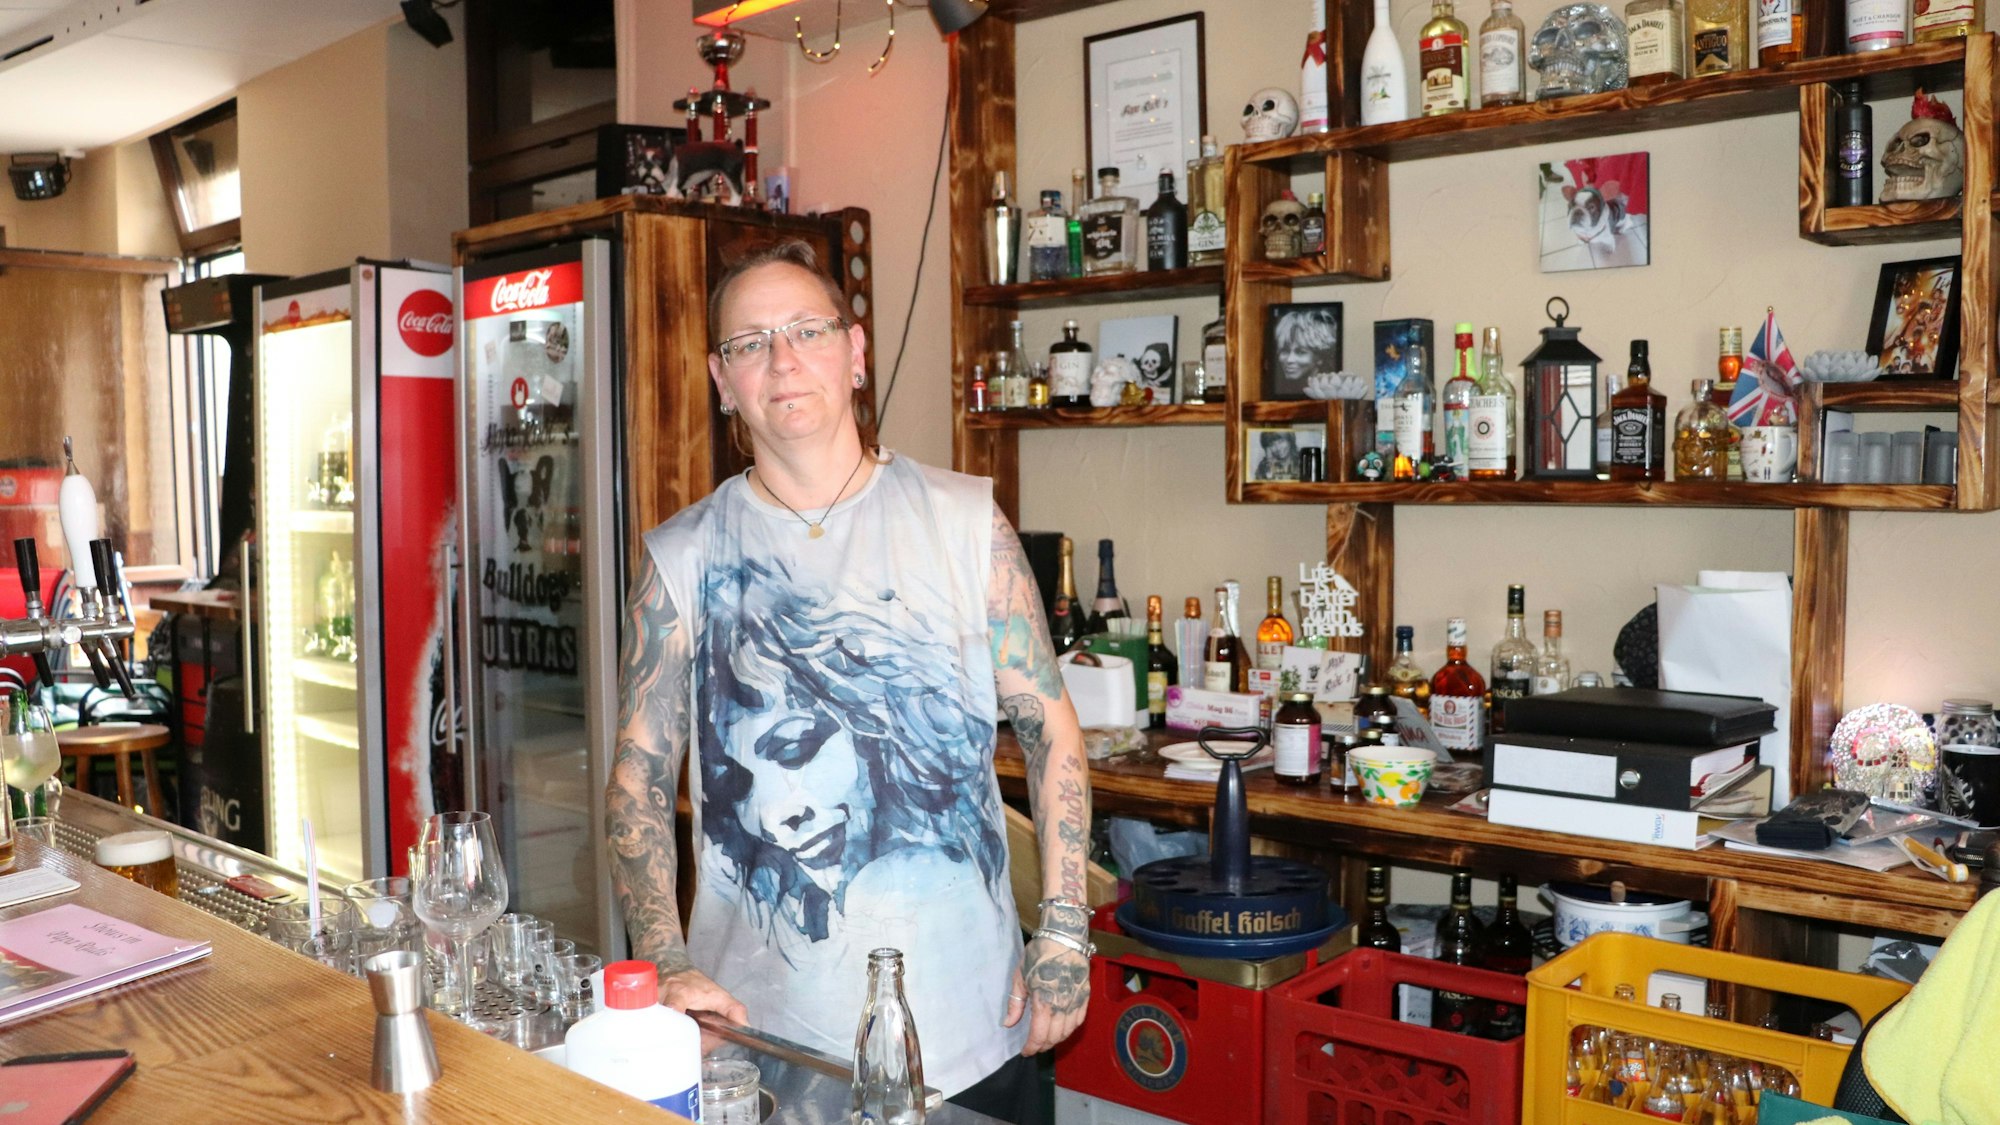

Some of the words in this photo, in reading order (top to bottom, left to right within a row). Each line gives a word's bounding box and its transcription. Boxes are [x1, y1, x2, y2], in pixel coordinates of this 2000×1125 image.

[1300, 561, 1335, 582] Life
[1301, 616, 1364, 637] friends
[482, 620, 577, 673] ULTRAS
[1238, 906, 1301, 934] Kölsch
[1119, 1004, 1183, 1043] PAULANER
